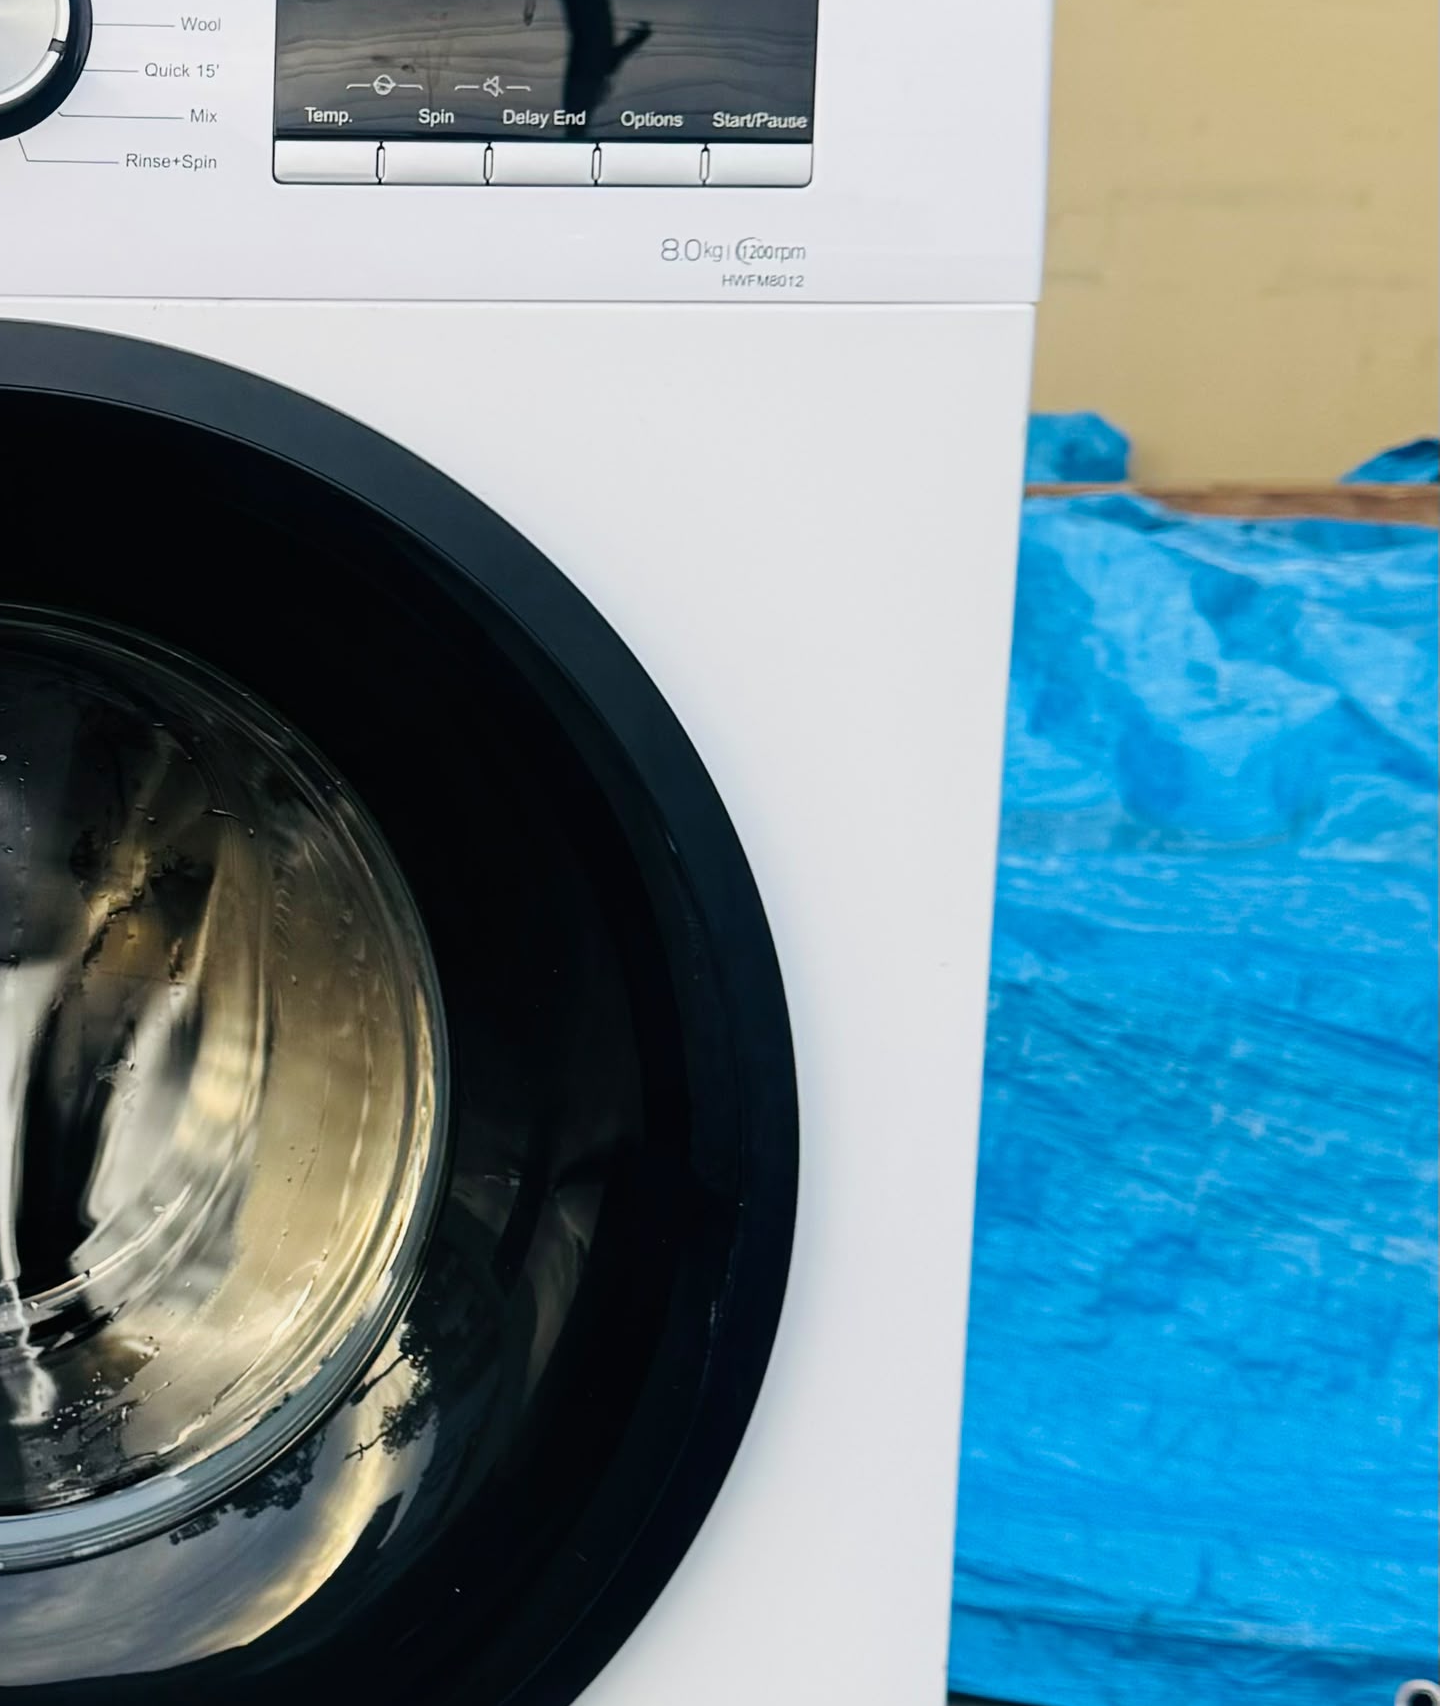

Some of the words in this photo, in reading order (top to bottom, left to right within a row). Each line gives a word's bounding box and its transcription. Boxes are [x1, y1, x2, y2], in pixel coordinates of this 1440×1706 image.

[181, 17, 221, 32] Wool
[144, 63, 191, 79] Quick
[196, 64, 220, 78] 15'
[190, 108, 217, 123] Mix
[305, 108, 353, 125] Temp.
[418, 109, 455, 127] Spin
[502, 109, 550, 127] Delay
[554, 110, 586, 125] End
[621, 111, 683, 130] Options
[712, 112, 808, 129] Start/Pause
[125, 153, 217, 172] Rinse+Spin
[722, 274, 805, 287] HWFM8012
